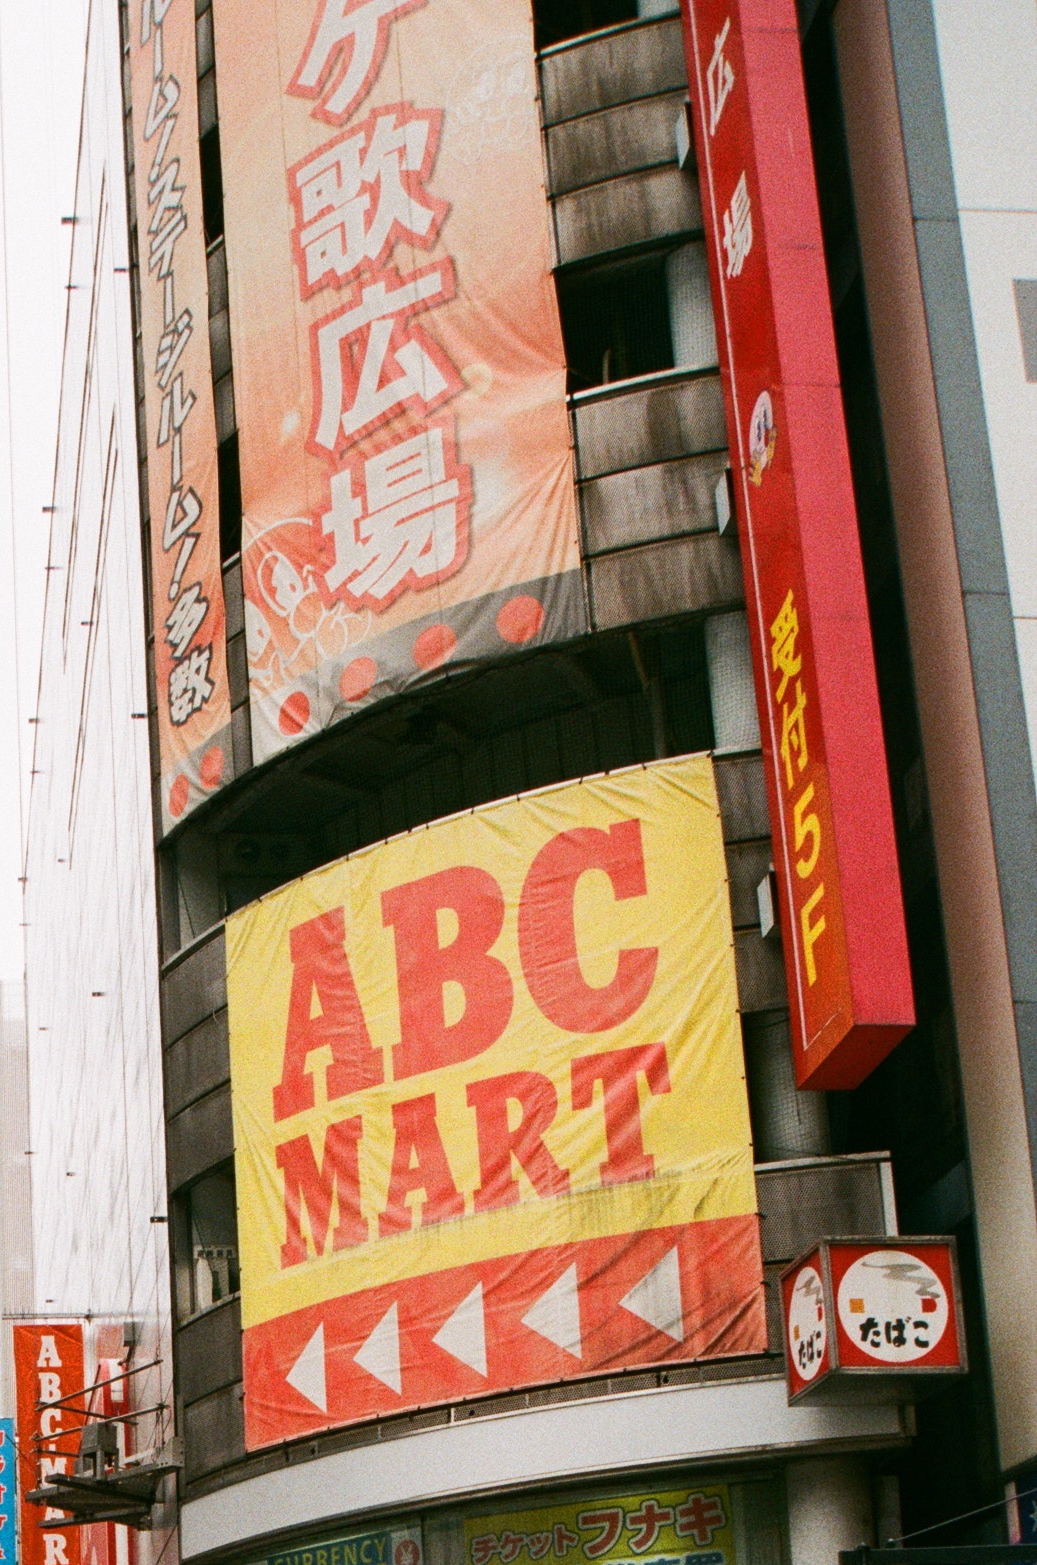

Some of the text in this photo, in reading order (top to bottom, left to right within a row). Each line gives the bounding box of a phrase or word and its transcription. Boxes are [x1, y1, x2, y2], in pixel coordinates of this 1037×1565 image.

[769, 587, 827, 988] 受付5F
[273, 816, 659, 1124] ABC
[273, 1042, 672, 1269] MART
[798, 1330, 822, 1370] たばこ
[859, 1316, 931, 1349] たばこ
